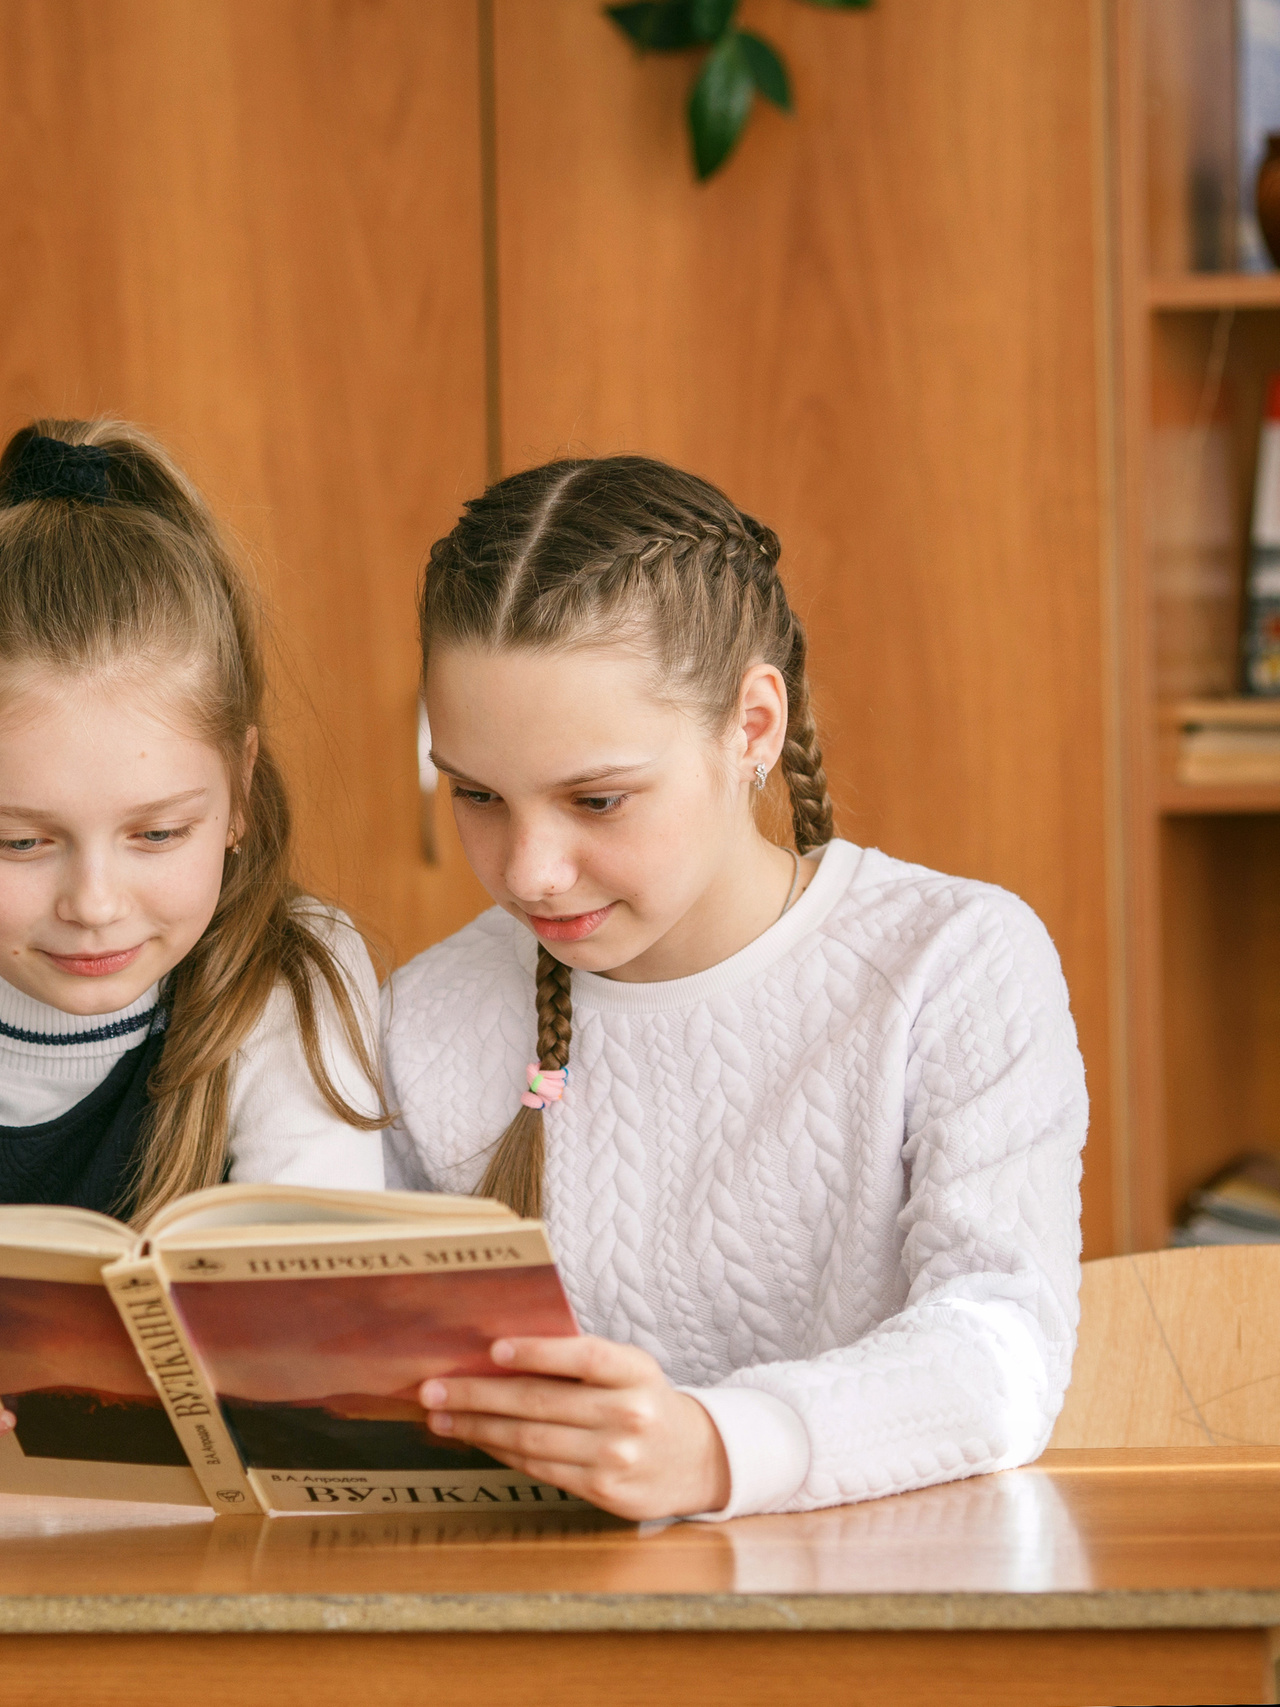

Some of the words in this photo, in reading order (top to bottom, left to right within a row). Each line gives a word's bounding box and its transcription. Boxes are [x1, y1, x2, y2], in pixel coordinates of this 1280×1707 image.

[248, 1251, 412, 1275] ПРИРОДА
[424, 1245, 522, 1267] МИРА
[126, 1297, 210, 1417] ВУЛКАНЫ
[303, 1475, 368, 1485] Апродов
[299, 1485, 580, 1503] ВУЛКАН
